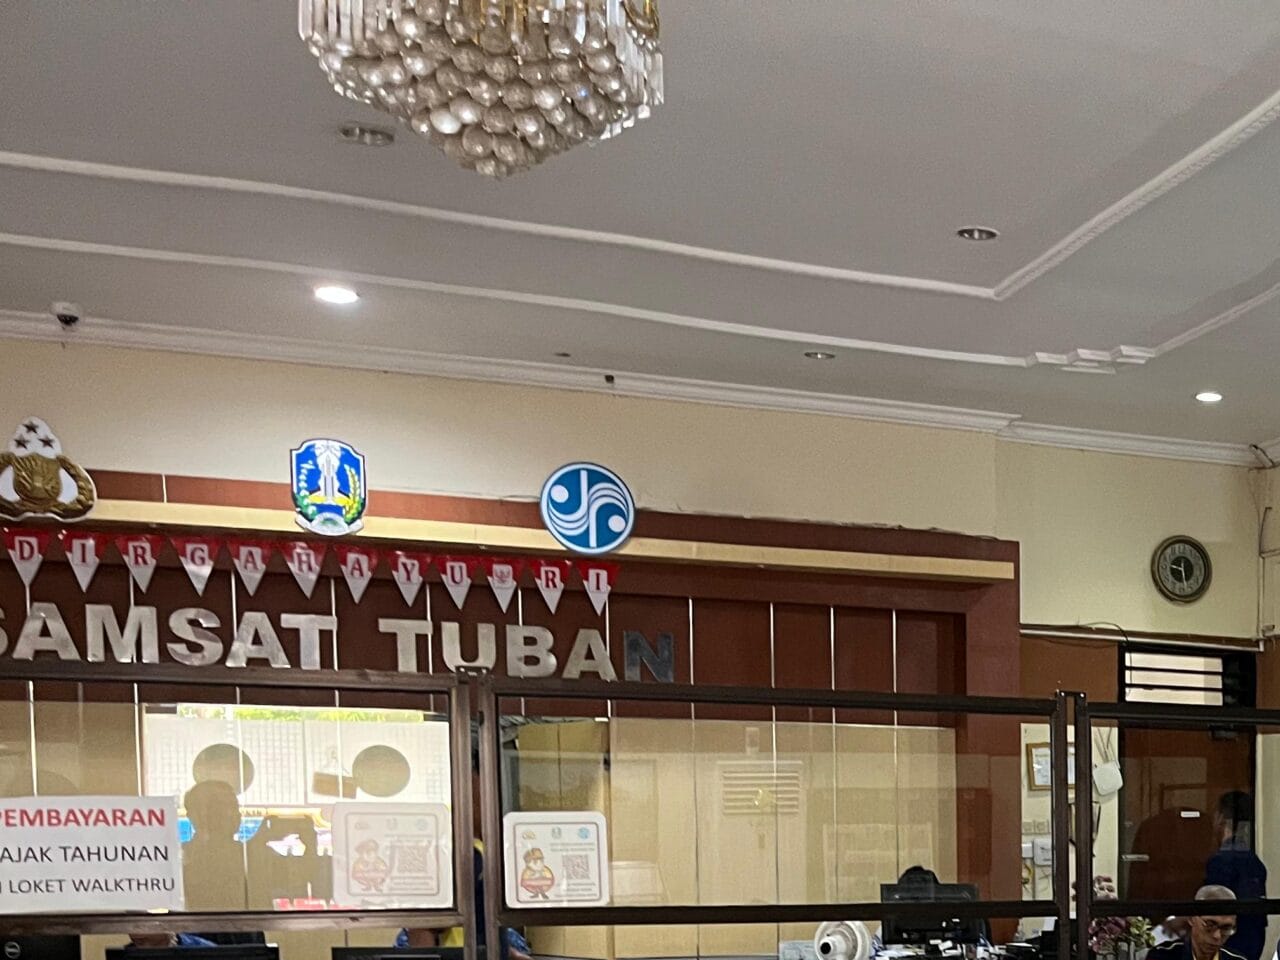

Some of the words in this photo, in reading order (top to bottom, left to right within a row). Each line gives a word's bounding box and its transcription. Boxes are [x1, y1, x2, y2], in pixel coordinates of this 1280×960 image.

[378, 617, 675, 683] TUBAN
[0, 808, 166, 828] EMBAYARAN
[59, 845, 169, 863] TAHUNAN
[9, 879, 66, 894] LOKET
[72, 877, 175, 893] WALKTHRU
